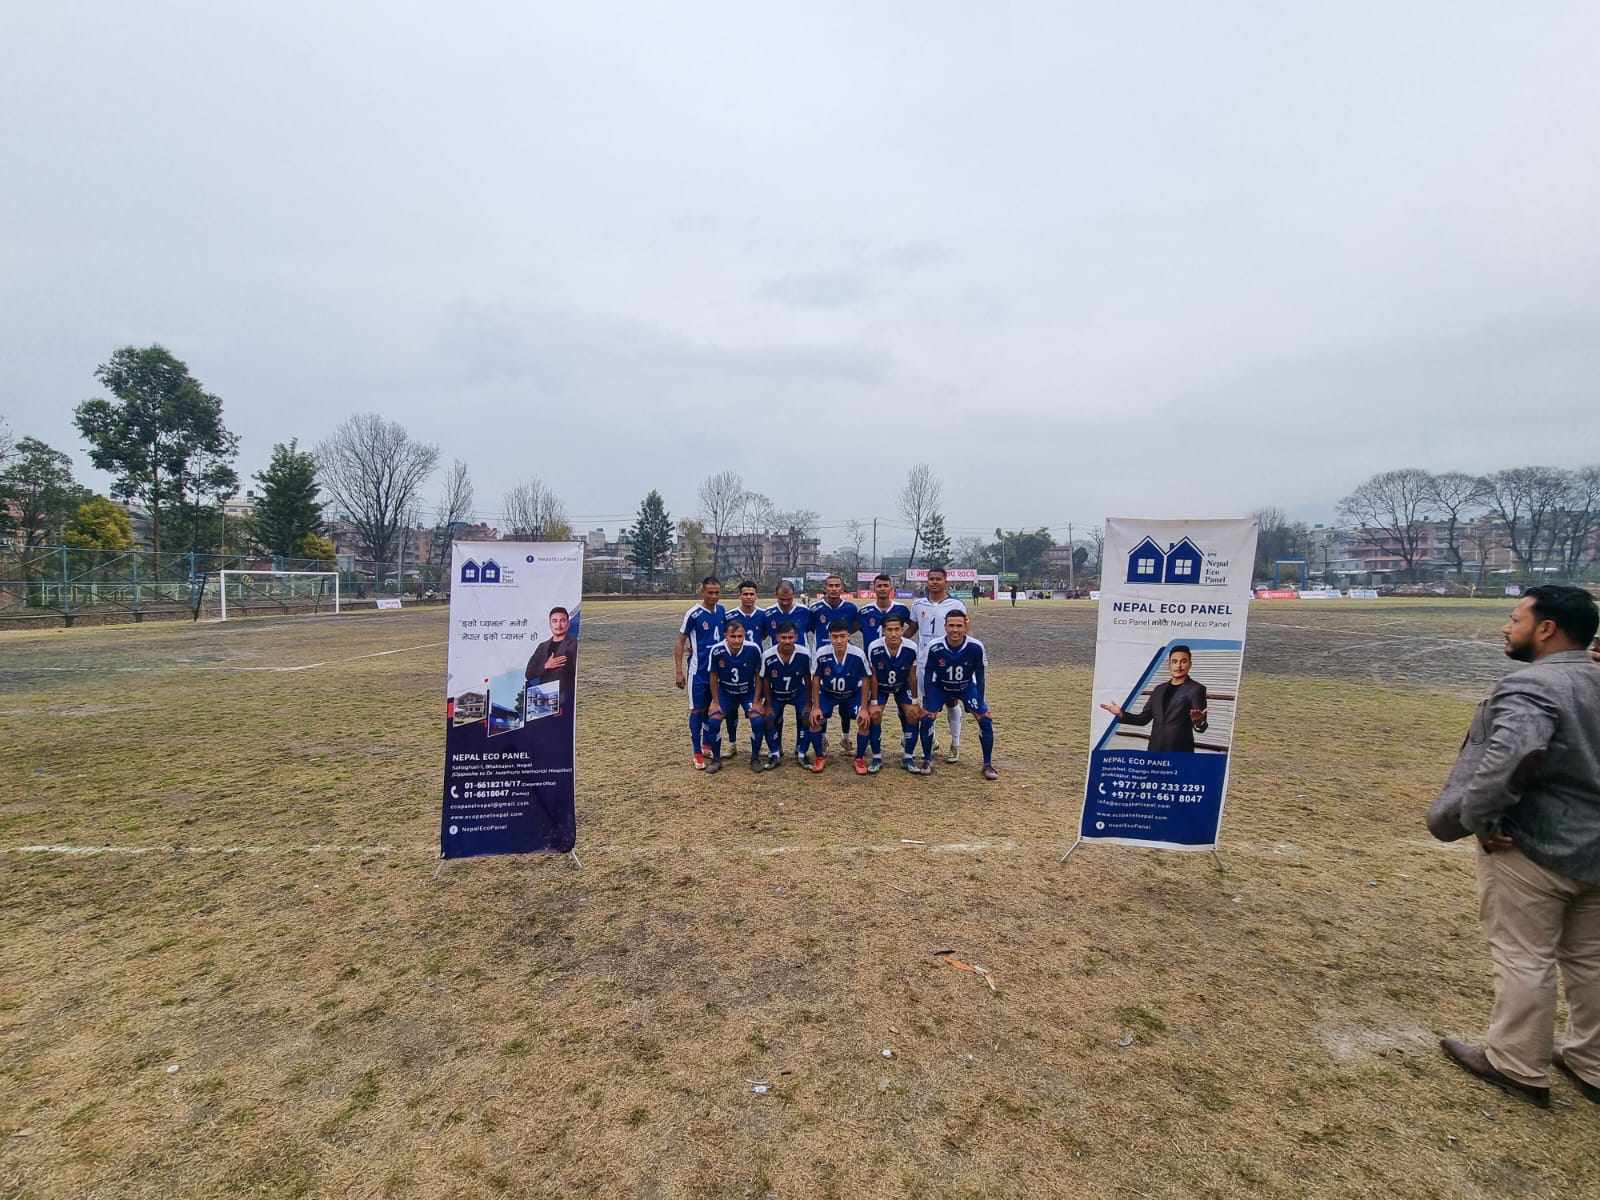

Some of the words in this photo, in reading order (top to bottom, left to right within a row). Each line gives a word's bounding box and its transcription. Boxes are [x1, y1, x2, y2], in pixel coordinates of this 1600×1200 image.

[1207, 560, 1228, 568] Nepal
[1113, 602, 1155, 612] NEPAL
[1160, 604, 1186, 614] ECO
[1191, 605, 1232, 614] PANEL
[930, 618, 935, 633] 1
[1171, 620, 1192, 628] Nepal
[731, 668, 739, 682] 3
[888, 670, 896, 684] 8
[946, 666, 963, 680] 18
[783, 676, 792, 690] 7
[830, 678, 845, 690] 10
[452, 753, 480, 761] NEPAL
[502, 752, 530, 760] PANEL
[1161, 782, 1180, 790] 233
[1182, 784, 1205, 792] 2291
[1112, 791, 1174, 801] +977-01-661
[1179, 794, 1202, 803] 8047
